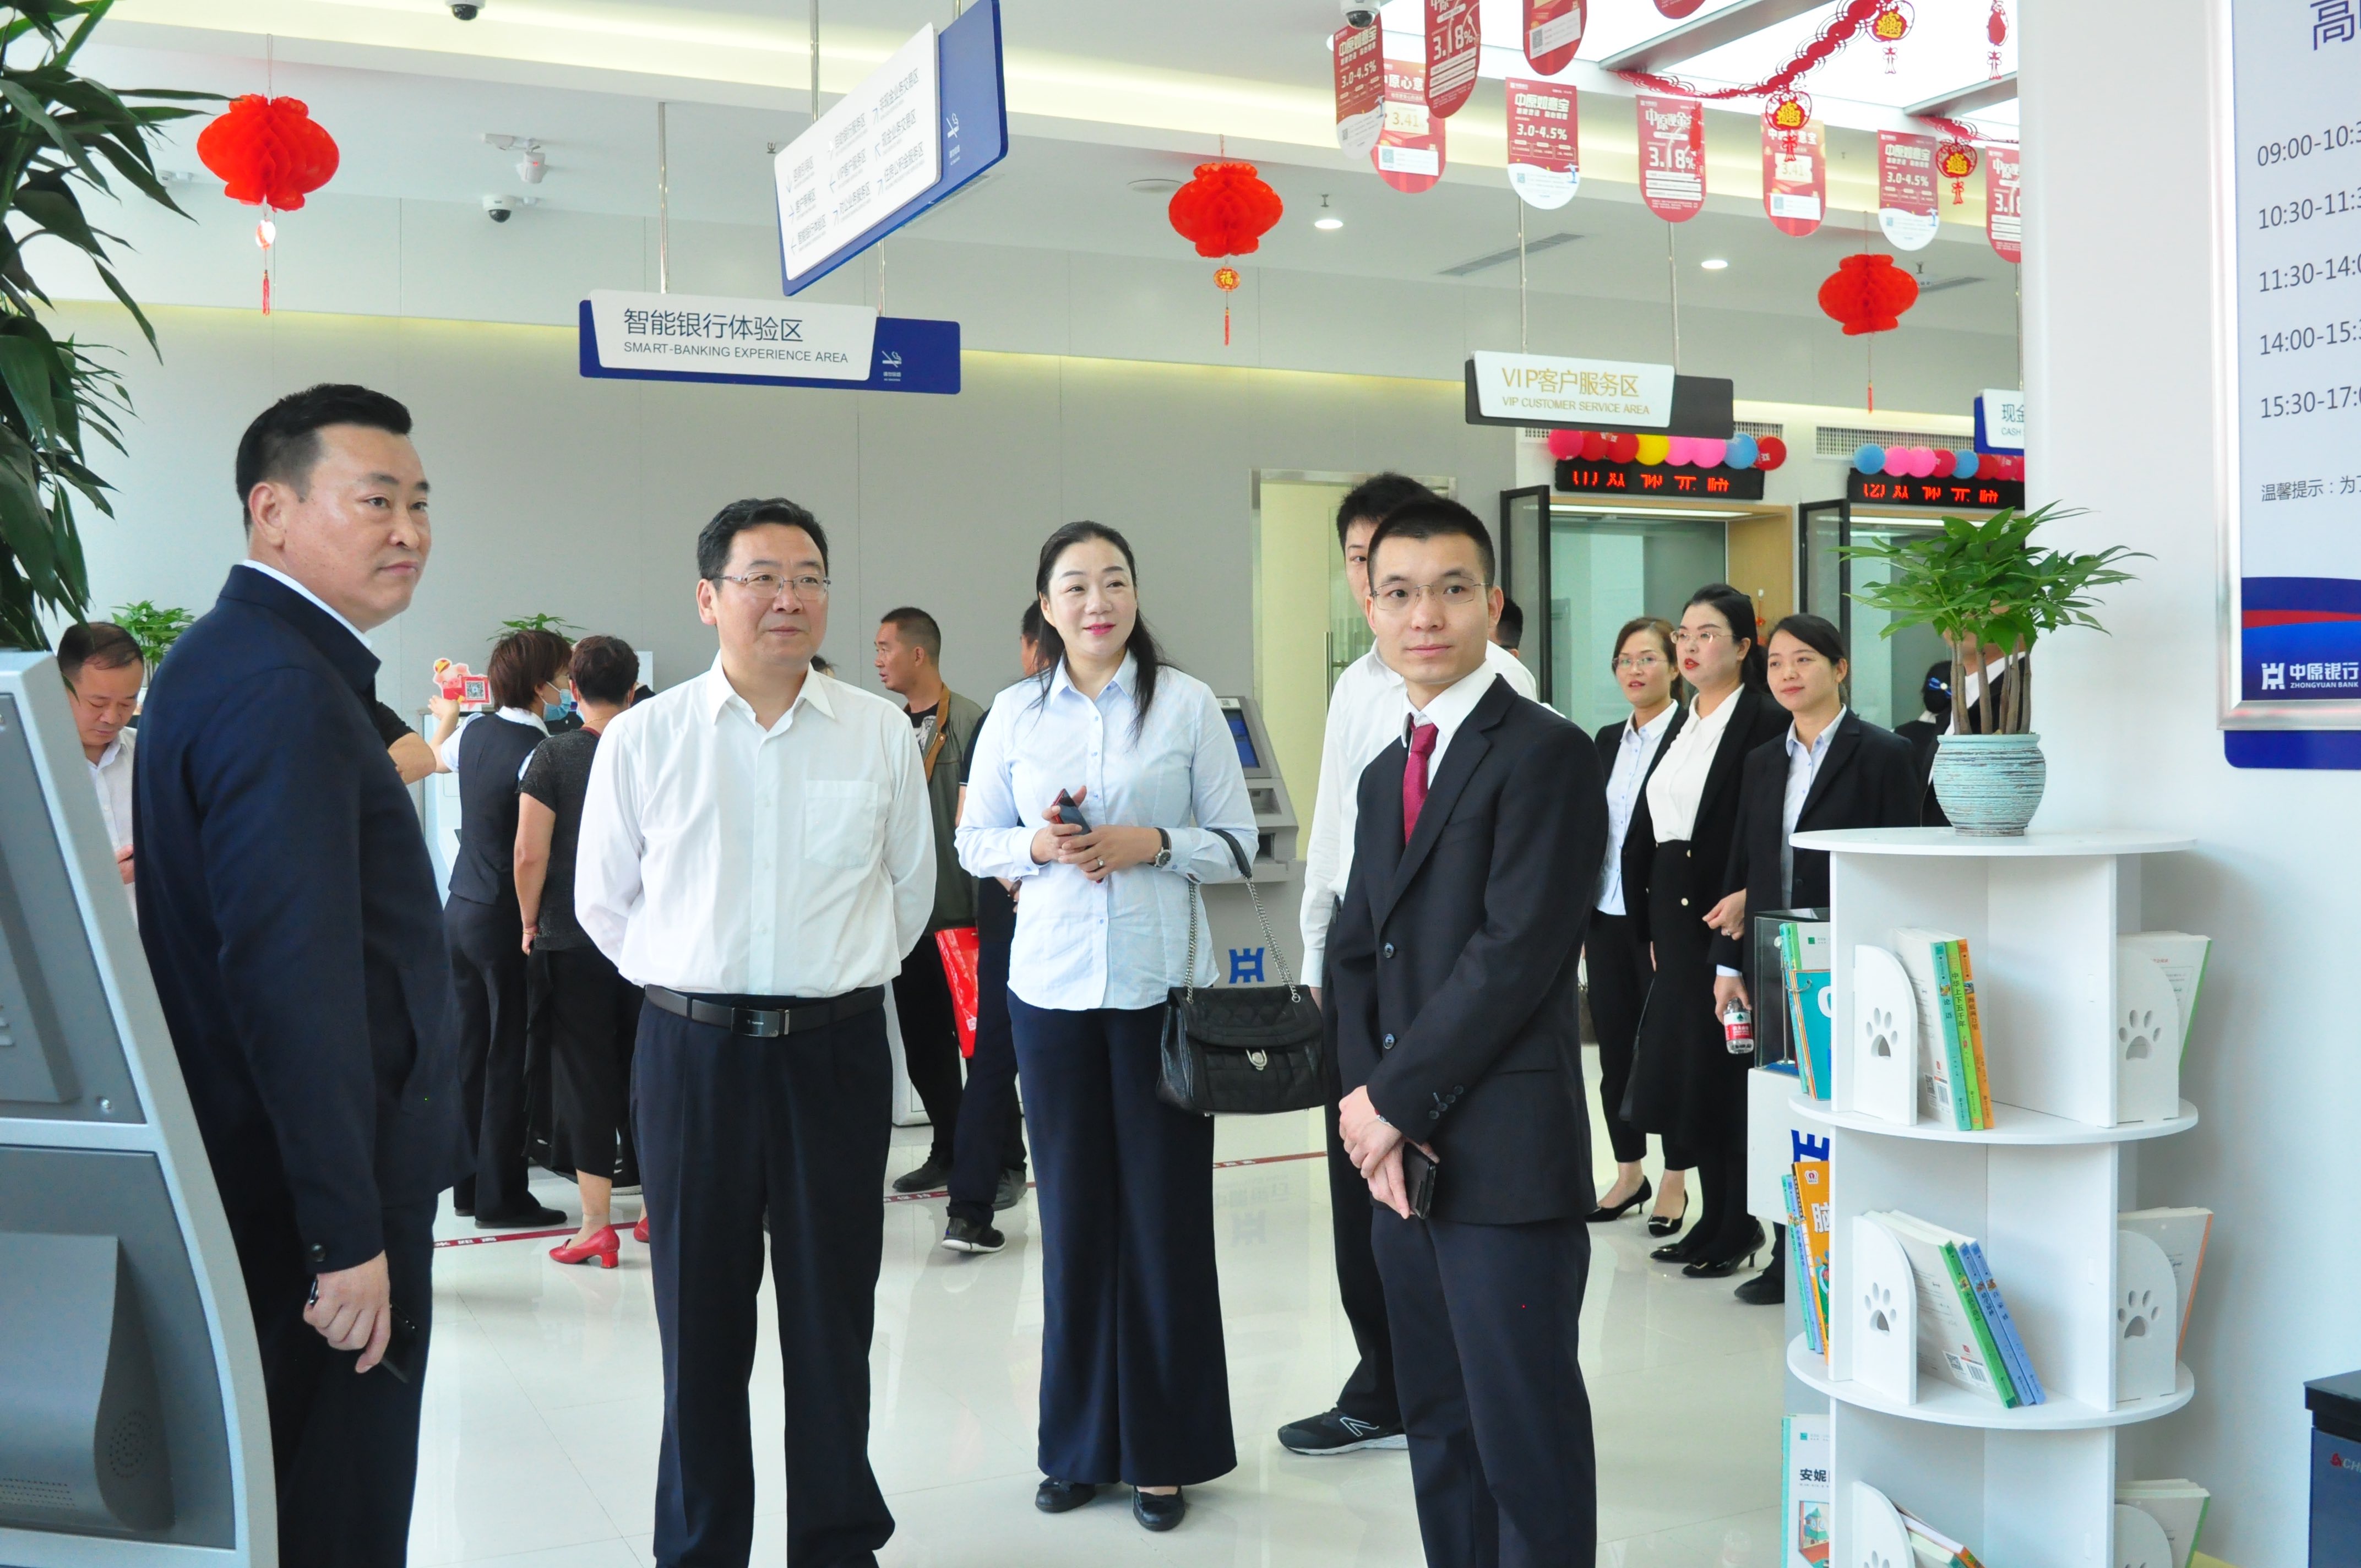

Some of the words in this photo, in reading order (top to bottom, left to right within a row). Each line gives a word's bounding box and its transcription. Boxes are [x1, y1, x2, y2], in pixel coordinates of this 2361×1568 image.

[2310, 0, 2361, 51] 高
[1341, 60, 1377, 89] 3.0-4.5%
[1516, 123, 1568, 140] 3.0-4.5%
[1886, 171, 1929, 187] 3.0-4.5%
[1220, 271, 1234, 285] 福
[624, 308, 803, 342] 智能银行体验区
[2260, 318, 2361, 355] 14:00-15:
[624, 341, 730, 357] SMART-BANKING
[735, 347, 811, 361] EXPERIENCE
[815, 351, 848, 363] AREA
[1502, 367, 1639, 398] VIP客户服务区
[1502, 396, 1519, 406] VIP
[1521, 398, 1576, 410] CUSTOMER
[1579, 401, 1620, 413] SERVICE
[1623, 404, 1650, 415] AREA
[2260, 385, 2361, 418] 15:30-17:
[2001, 427, 2021, 435] CASH
[2289, 662, 2359, 680] 中原银行
[1944, 998, 1952, 1019] 论语
[1951, 972, 1966, 1027] 中华上下五千年
[1799, 1468, 1830, 1483] 安妮
[2343, 1458, 2361, 1473] CH
